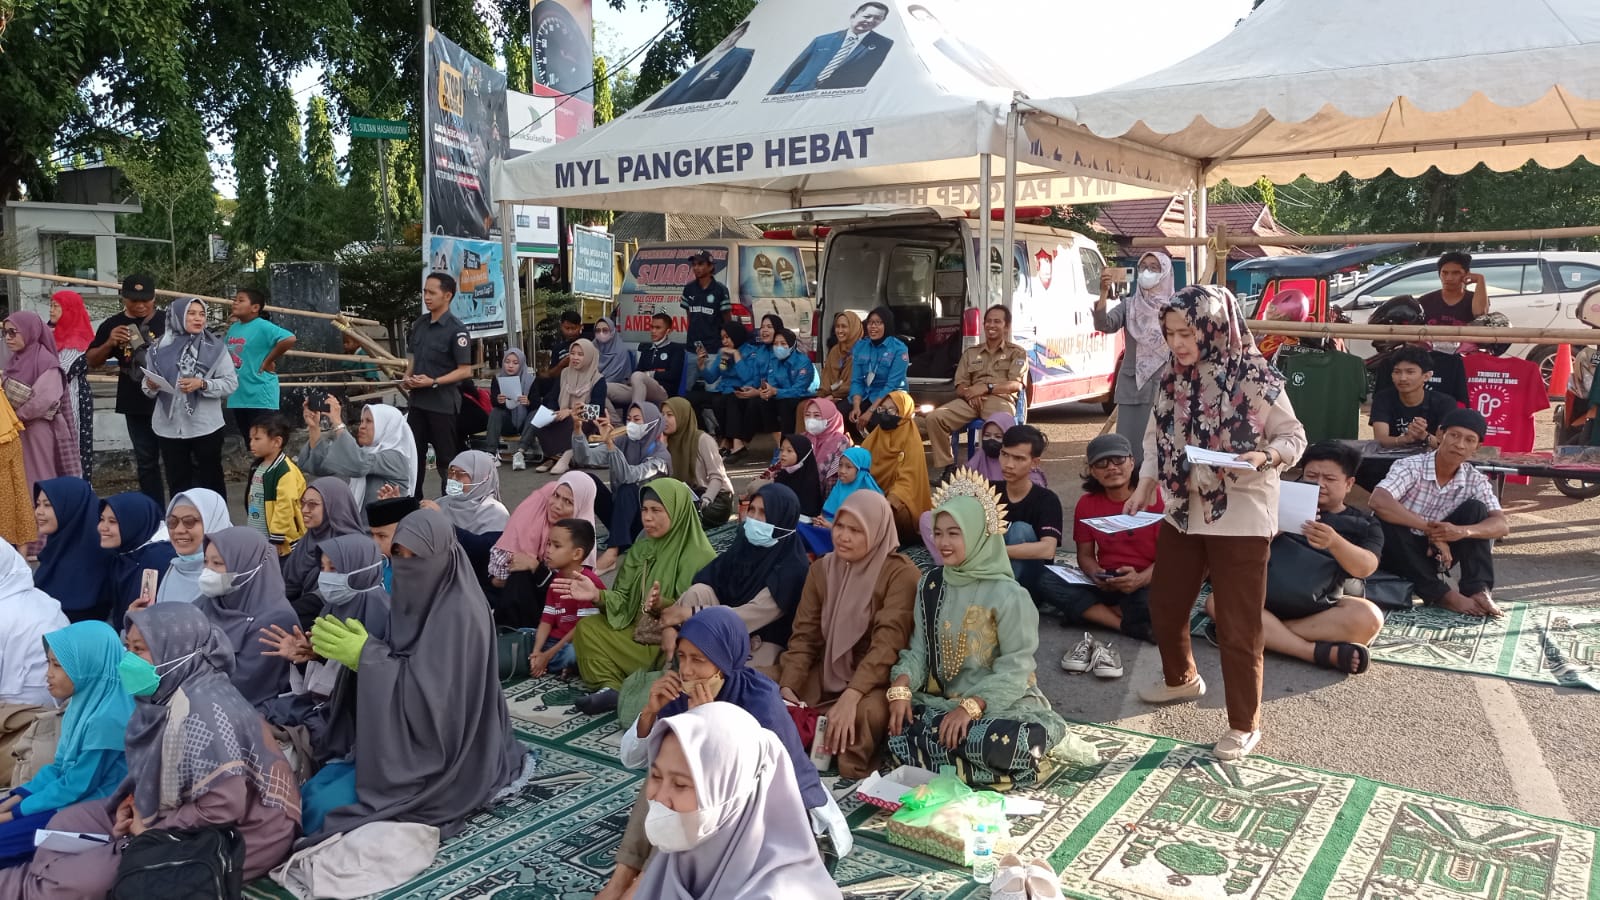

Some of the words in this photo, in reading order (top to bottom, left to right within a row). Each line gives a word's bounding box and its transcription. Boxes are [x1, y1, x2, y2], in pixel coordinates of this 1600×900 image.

[555, 157, 610, 190] MYL
[617, 141, 754, 184] PANGKEP
[764, 126, 875, 170] HEBAT
[645, 295, 664, 303] CENTER
